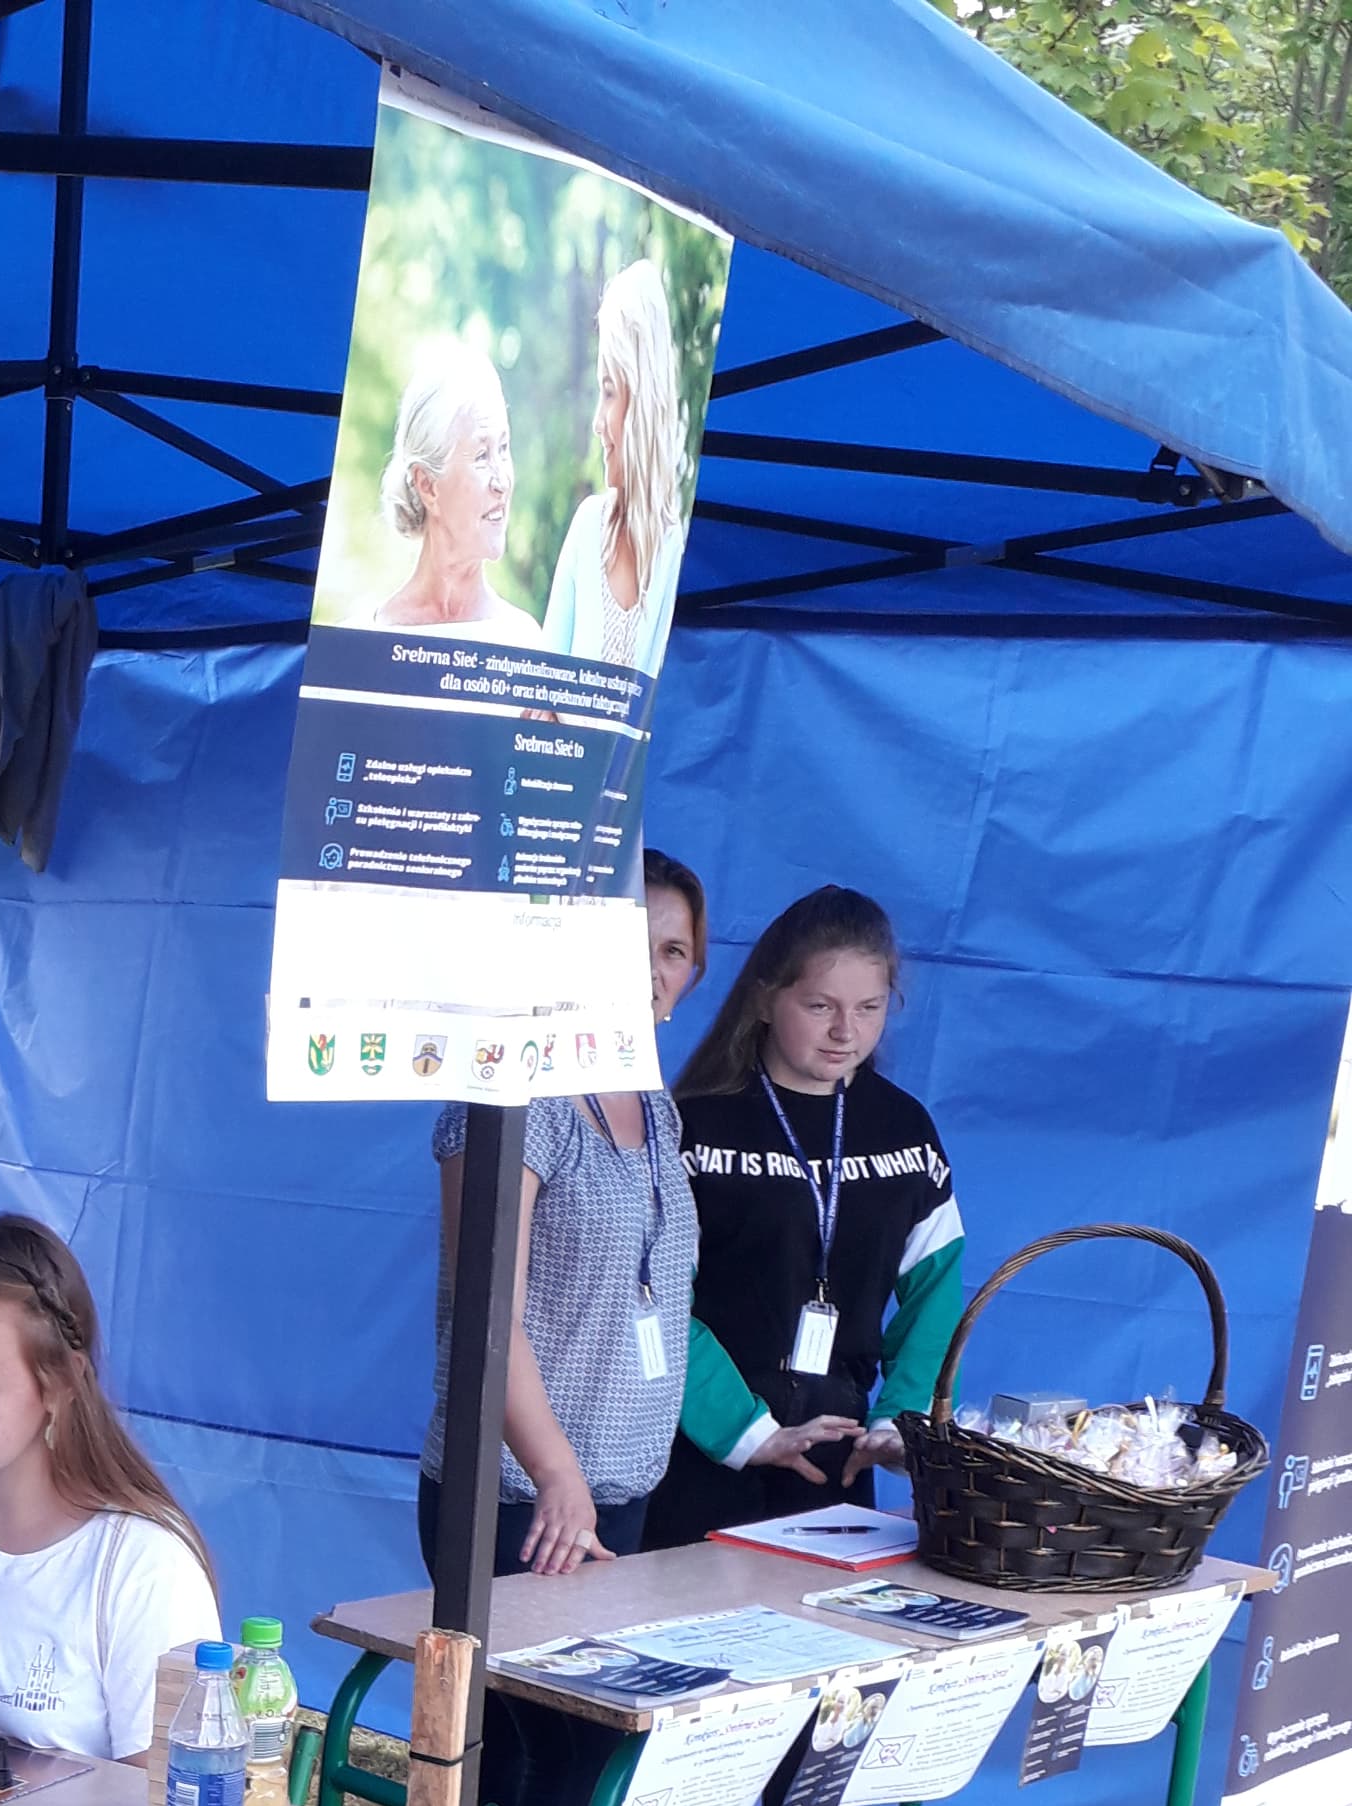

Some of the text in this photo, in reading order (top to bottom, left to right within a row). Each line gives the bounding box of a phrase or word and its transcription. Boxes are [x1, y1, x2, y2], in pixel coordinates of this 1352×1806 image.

[392, 644, 450, 666] Srebrna
[452, 649, 478, 669] Sieć
[440, 673, 461, 691] dla
[464, 676, 490, 694] osób
[491, 678, 512, 696] 60+
[512, 684, 535, 699] oraz
[536, 684, 548, 700] ich
[514, 733, 585, 759] Srebrna Sieć to
[741, 1151, 763, 1177] IS
[869, 1146, 926, 1178] WHAT
